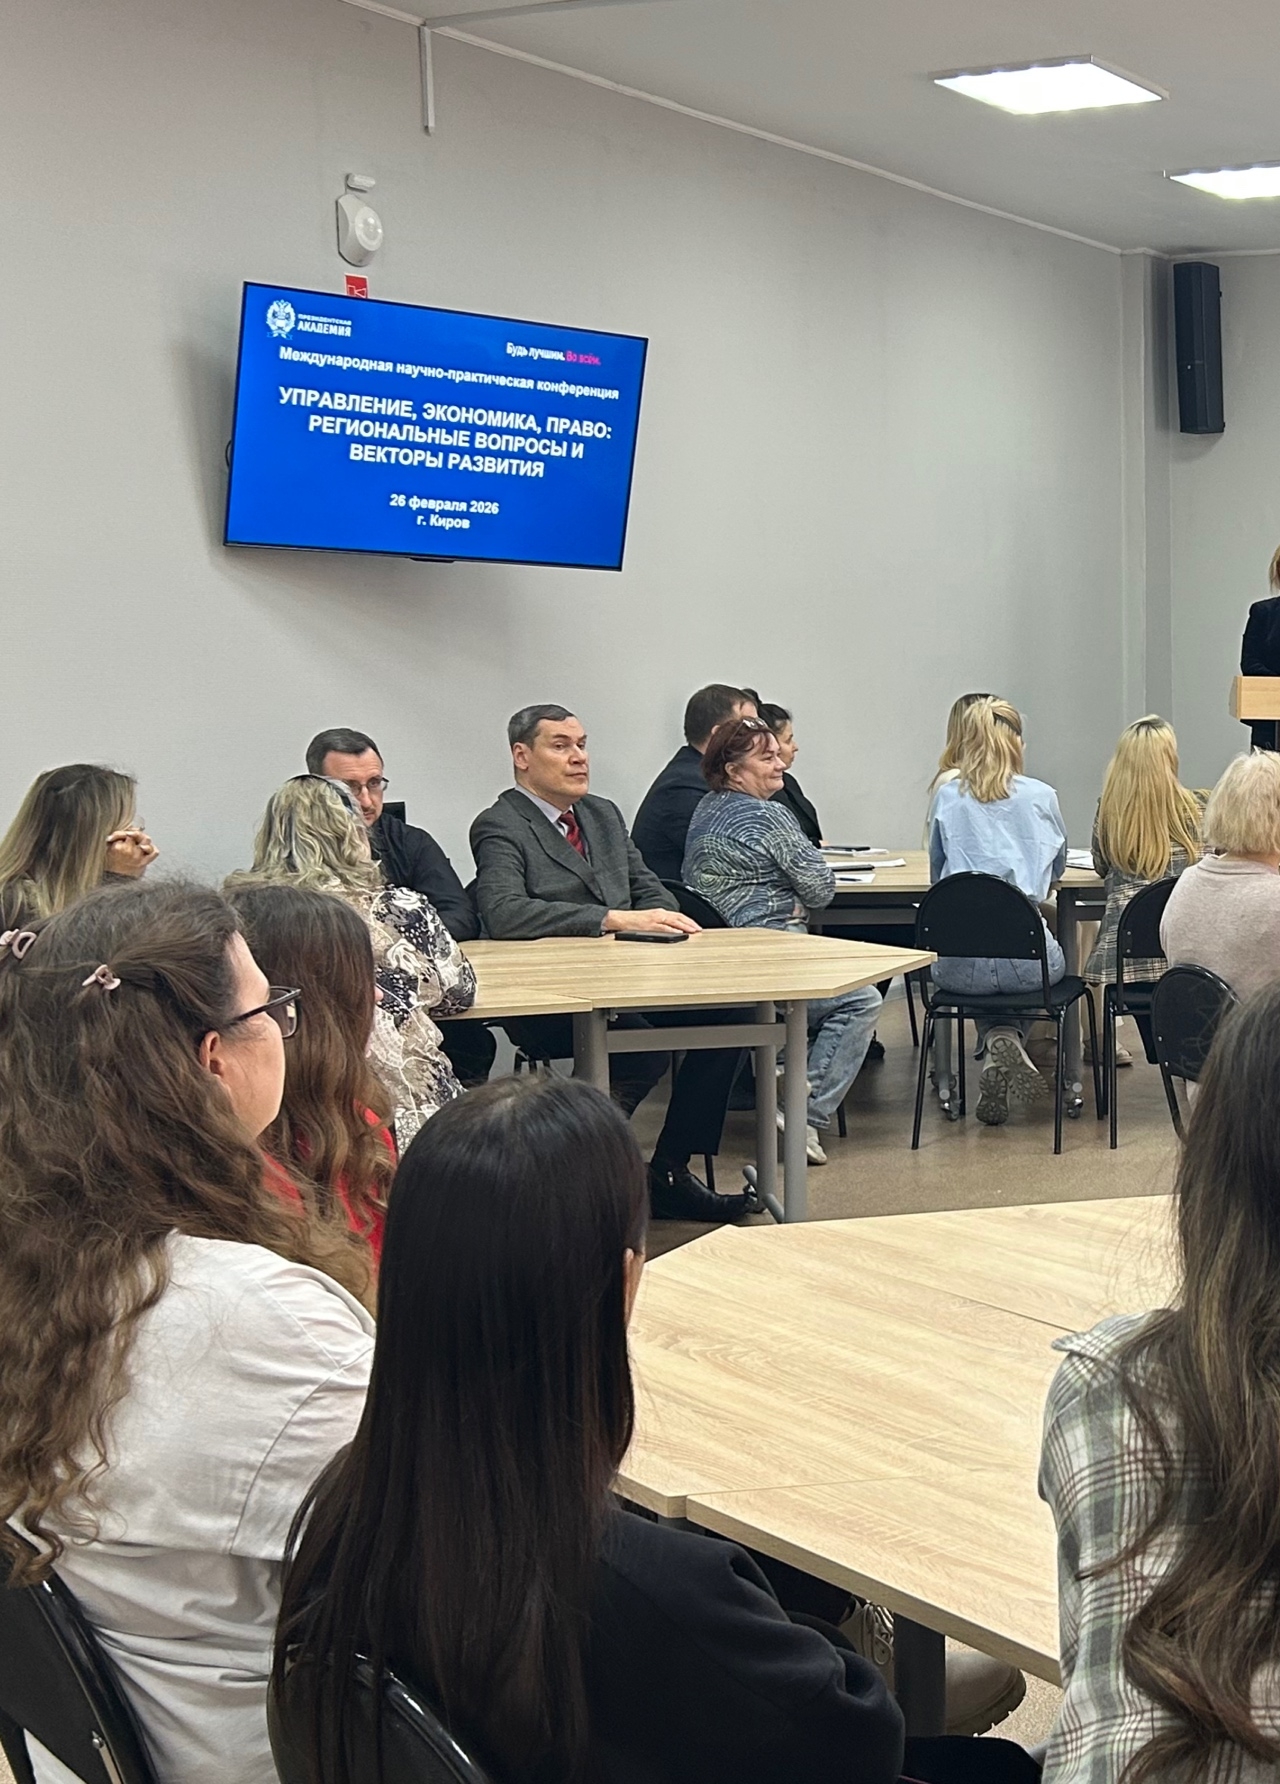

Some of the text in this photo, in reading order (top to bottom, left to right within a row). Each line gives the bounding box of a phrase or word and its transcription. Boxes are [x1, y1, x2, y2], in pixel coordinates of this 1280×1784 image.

[297, 320, 351, 337] АКАДЕМИЯ
[505, 341, 528, 357] Будь
[279, 346, 619, 399] Международная научно-практическая конференция
[279, 386, 612, 439] УПРАВЛЕНИЕ, ЭКОНОМИКА, ПРАВО:
[308, 414, 584, 458] РЕГИОНАЛЬНЫЕ ВОПРОСЫ И
[349, 443, 545, 477] ВЕКТОРЫ РАЗВИТИЯ
[389, 494, 499, 514] 26 февраля 2026
[417, 514, 470, 530] г. Киров
